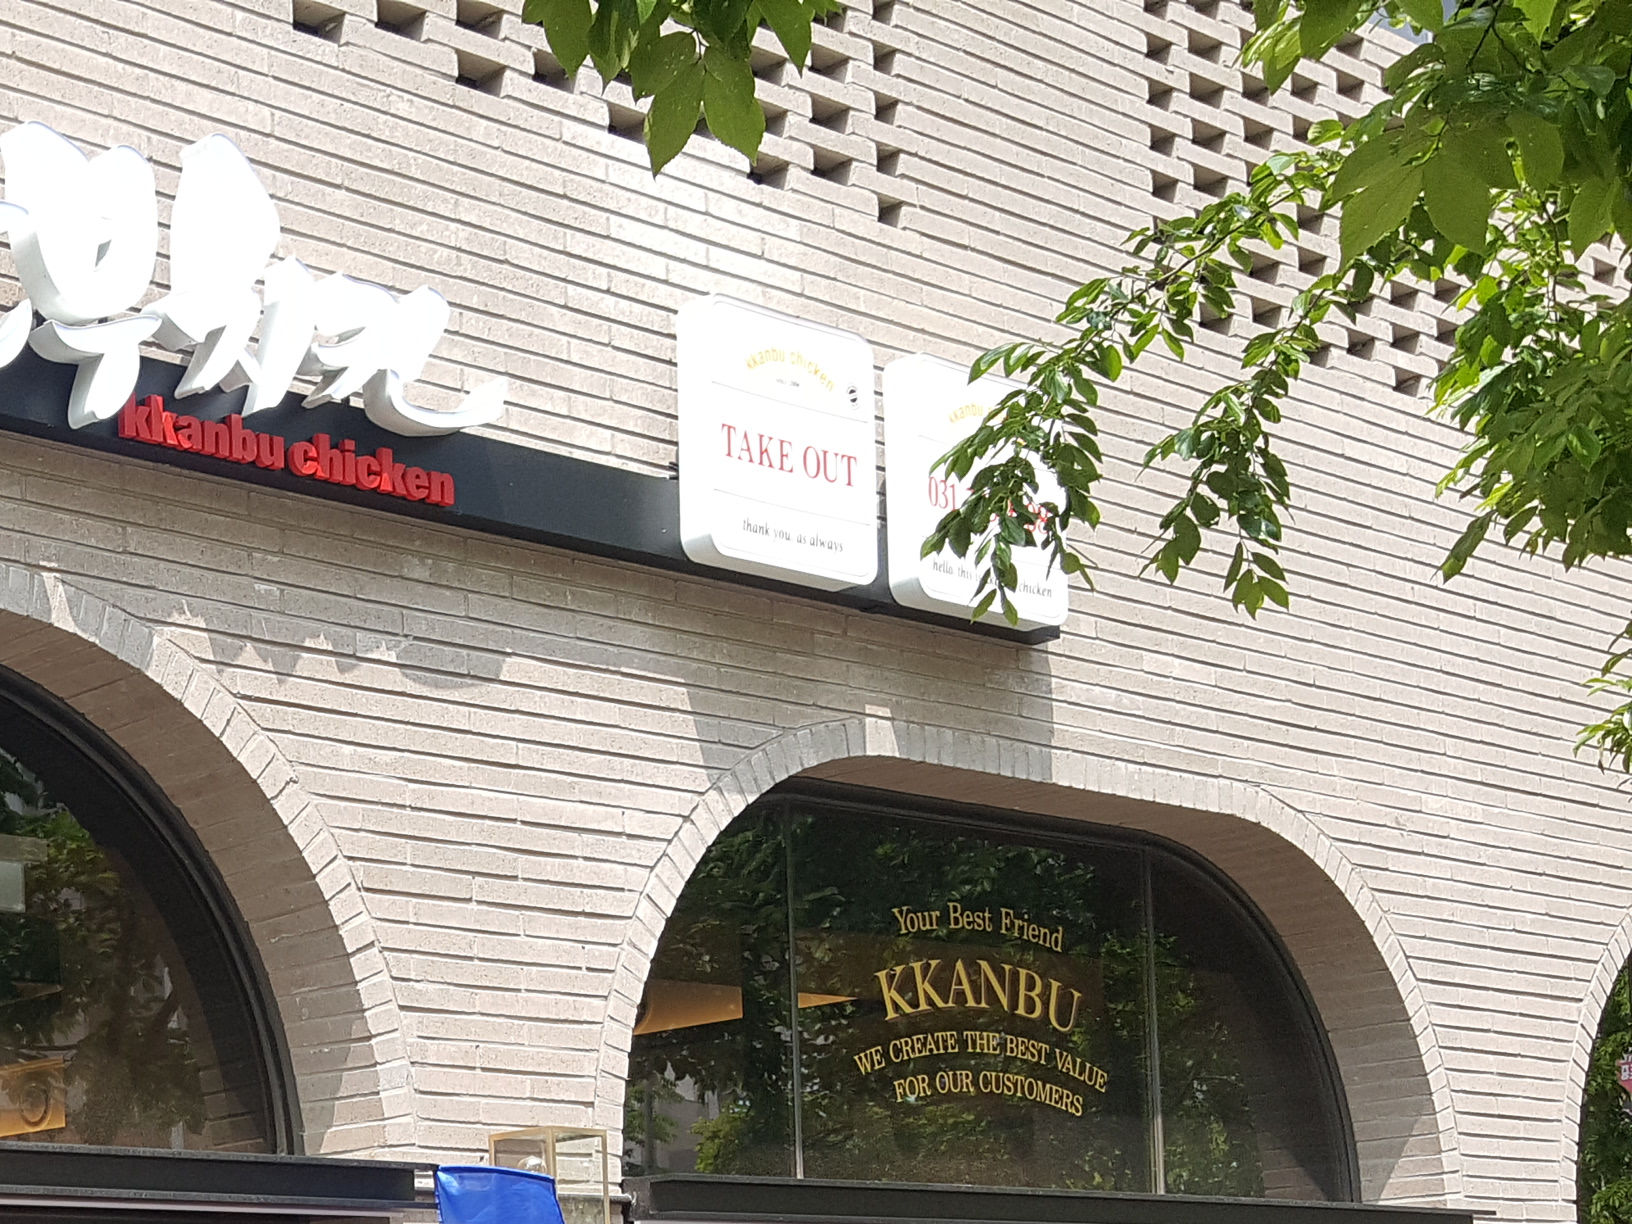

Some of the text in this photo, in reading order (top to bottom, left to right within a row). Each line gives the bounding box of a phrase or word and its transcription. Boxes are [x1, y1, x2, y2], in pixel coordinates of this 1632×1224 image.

[745, 345, 835, 392] kkanbu chicken
[119, 392, 455, 507] kkanbu chicken
[720, 422, 858, 488] TAKE OUT
[742, 517, 770, 539] thank
[796, 533, 808, 546] as
[809, 530, 844, 554] always
[1018, 579, 1053, 599] chicken
[891, 901, 1064, 953] Your Best Friend
[874, 957, 1083, 1034] KKANBU
[853, 1030, 1109, 1094] WE CREATE THE BEST VALUE
[893, 1070, 1085, 1118] FOR OUR CUSTOMERS
